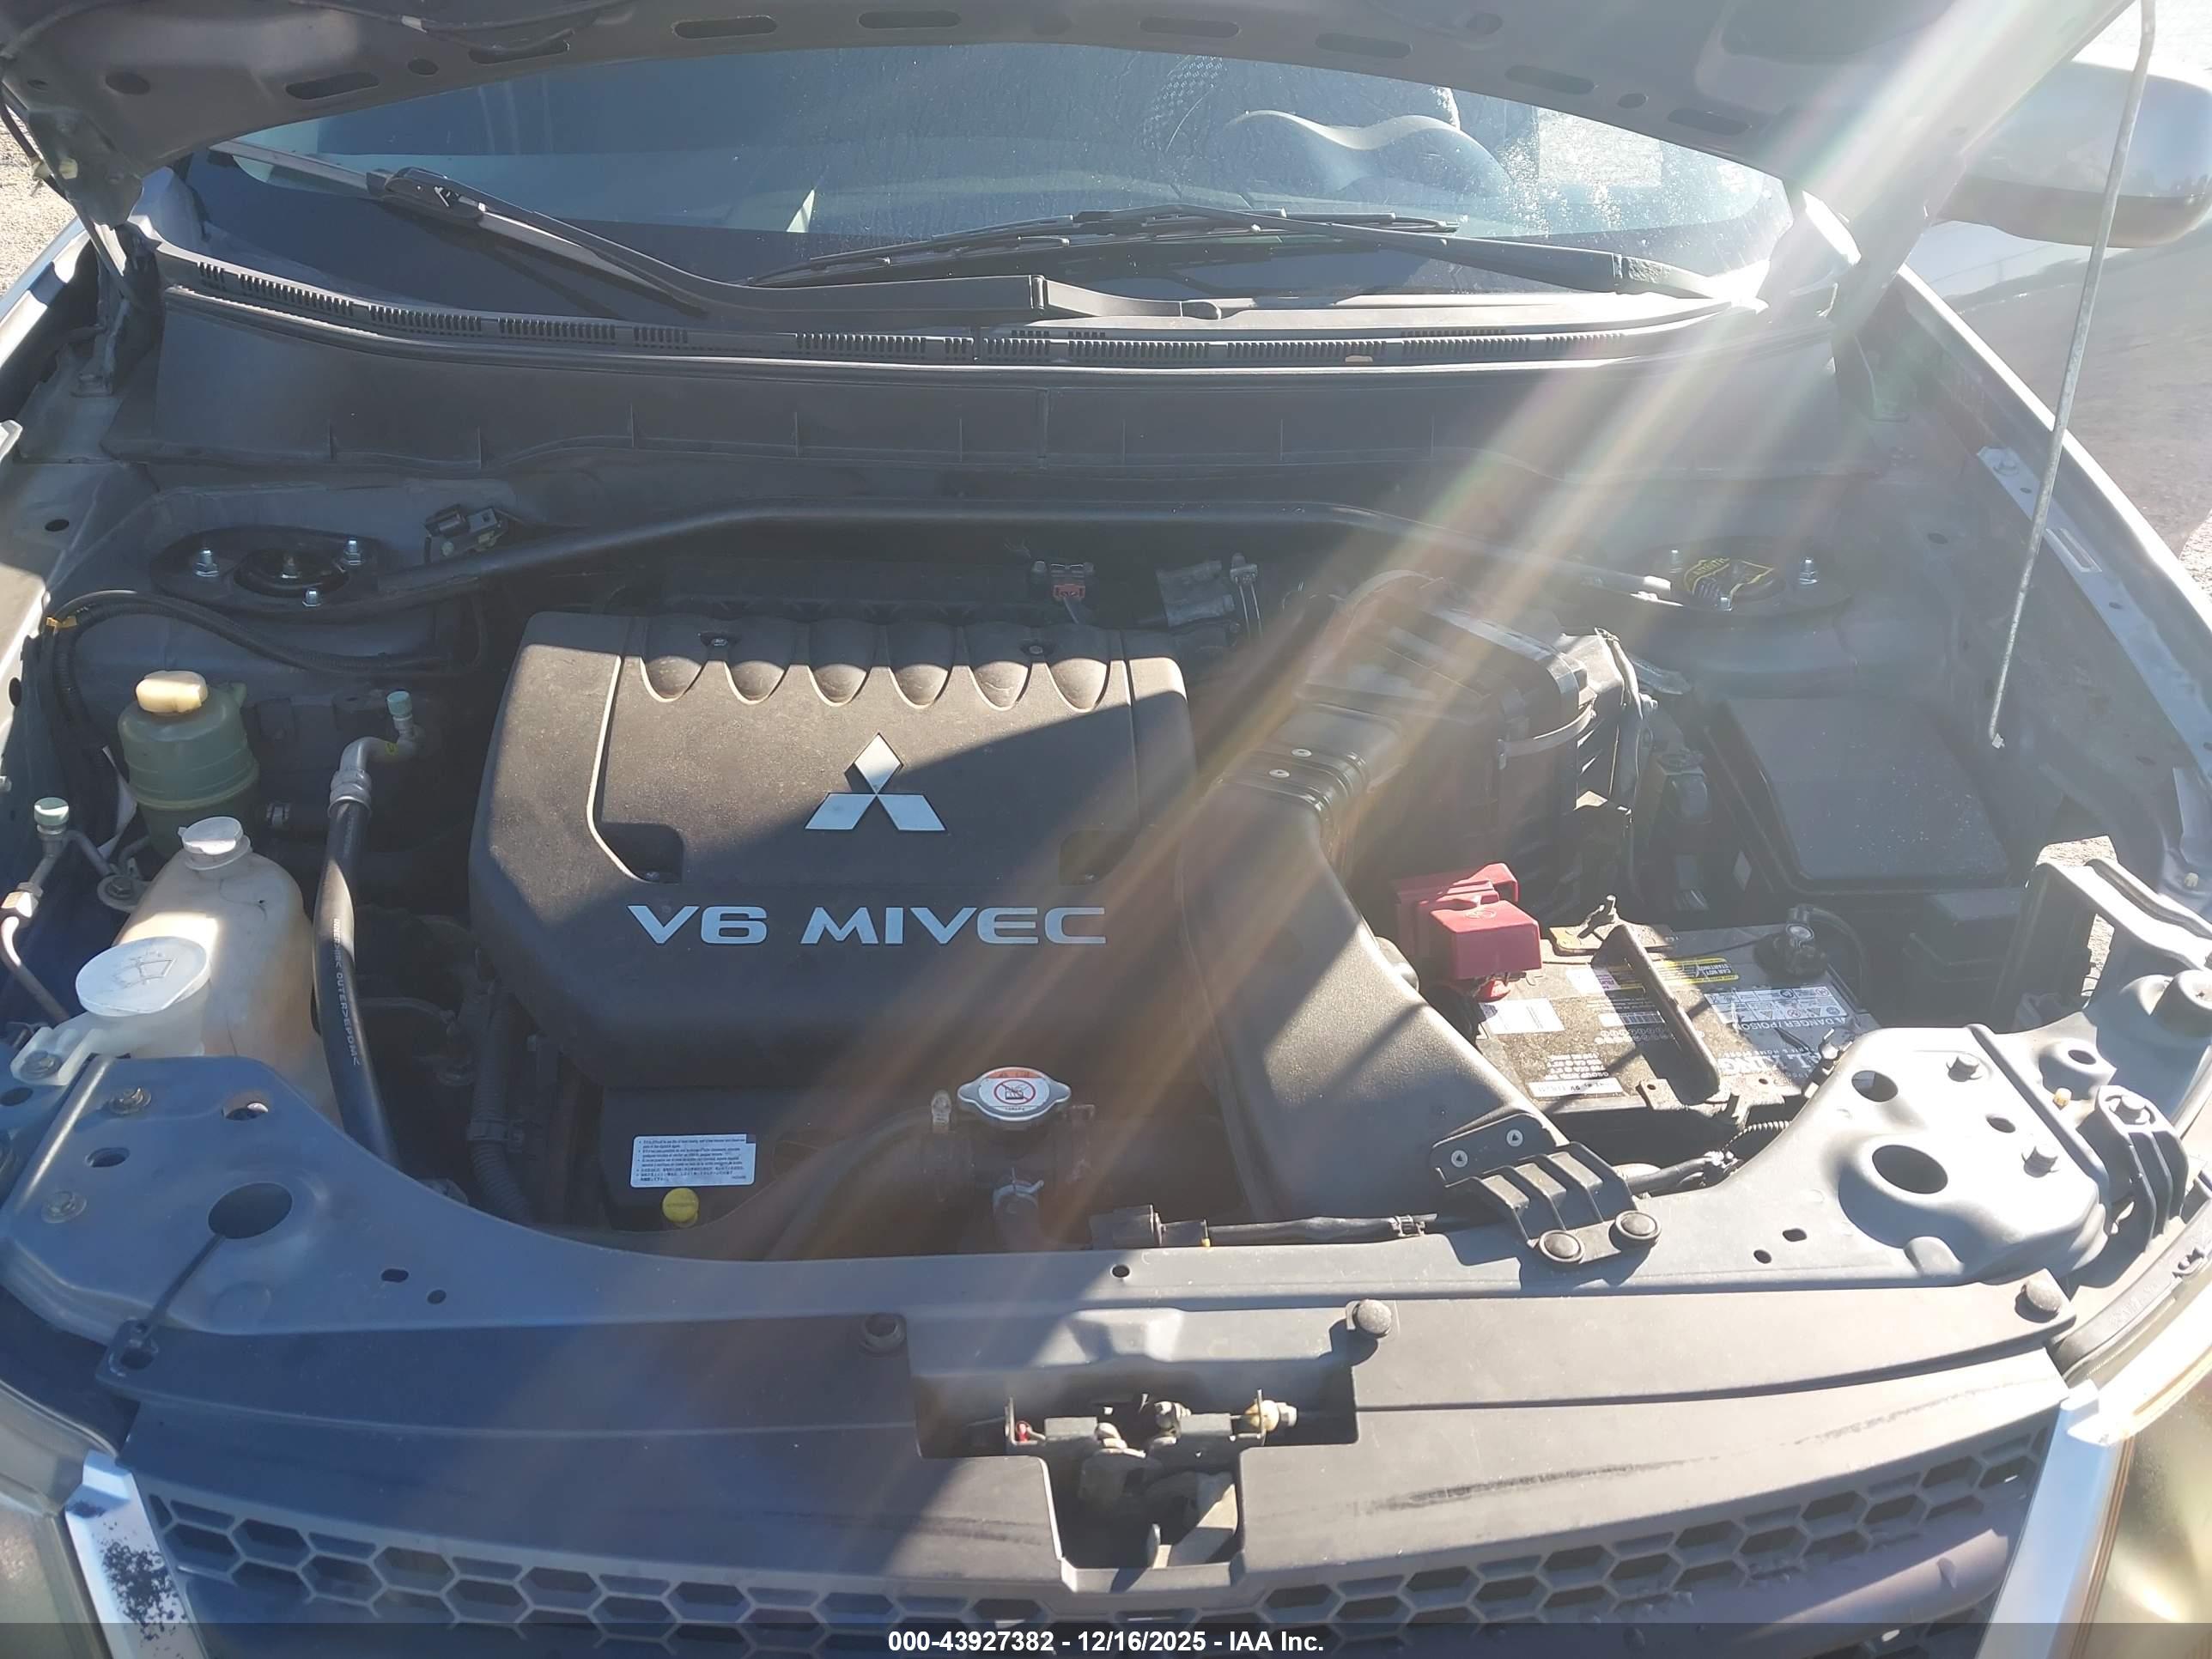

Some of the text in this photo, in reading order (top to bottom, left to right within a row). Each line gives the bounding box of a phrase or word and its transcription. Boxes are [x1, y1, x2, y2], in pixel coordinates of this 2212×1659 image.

[628, 905, 1107, 944] V6 MIVEC
[1784, 1017, 1835, 1028] DANGER
